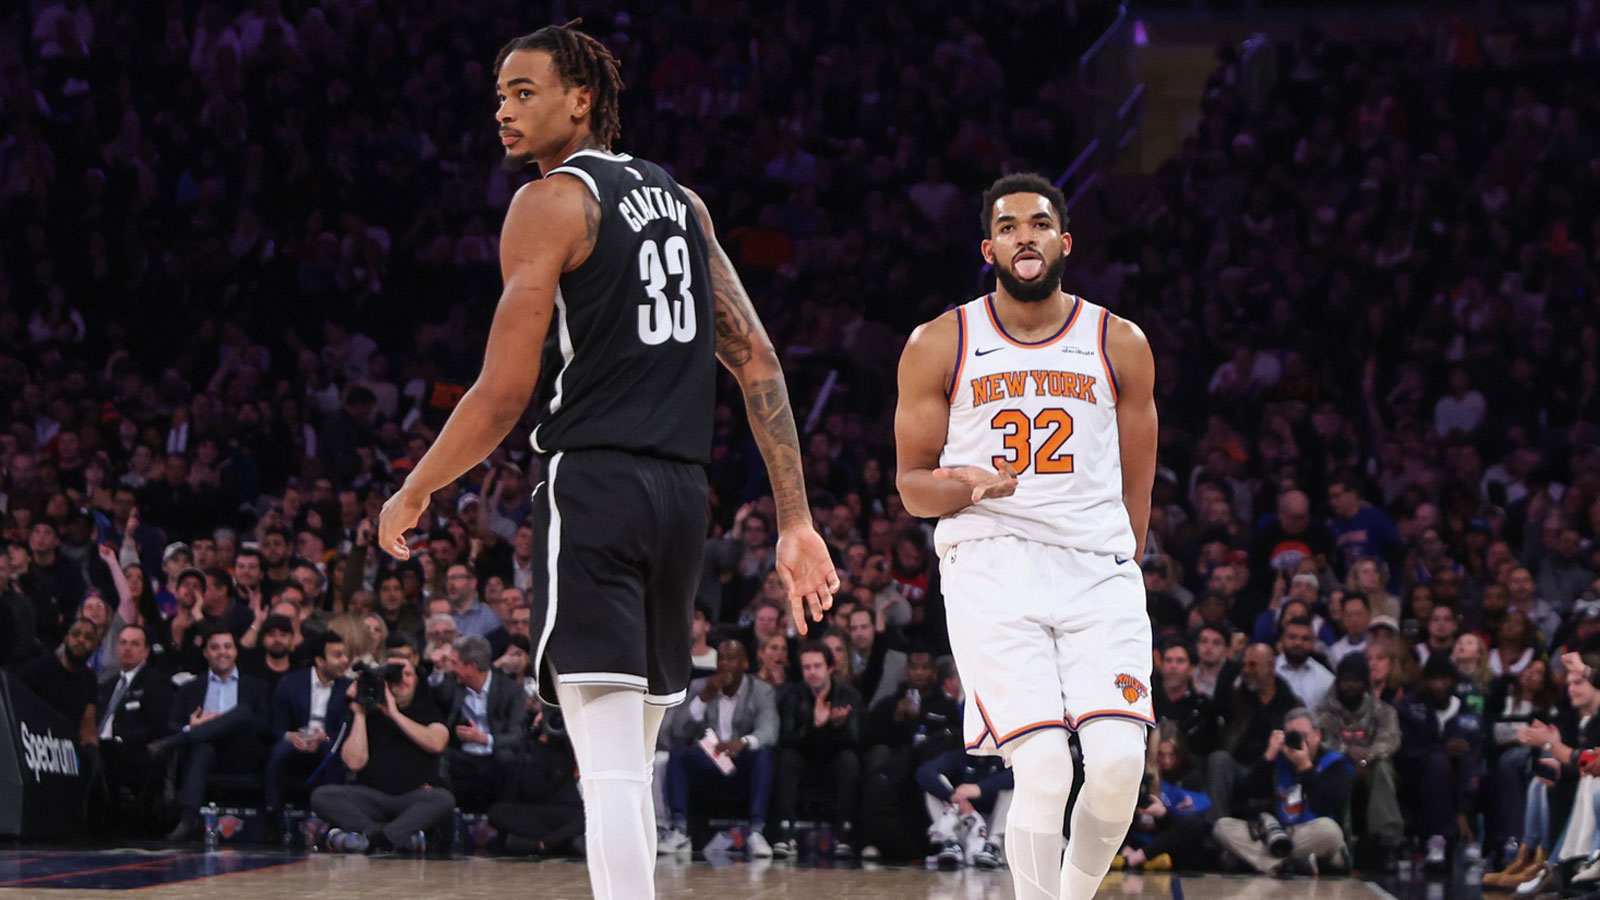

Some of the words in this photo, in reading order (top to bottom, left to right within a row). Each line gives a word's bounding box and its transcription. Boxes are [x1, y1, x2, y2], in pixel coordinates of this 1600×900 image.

[618, 186, 687, 233] CLAXTON
[638, 235, 697, 345] 33
[971, 371, 1028, 408] NEW
[1030, 370, 1097, 405] YORK
[991, 408, 1074, 476] 32
[20, 721, 79, 783] Spectrum
